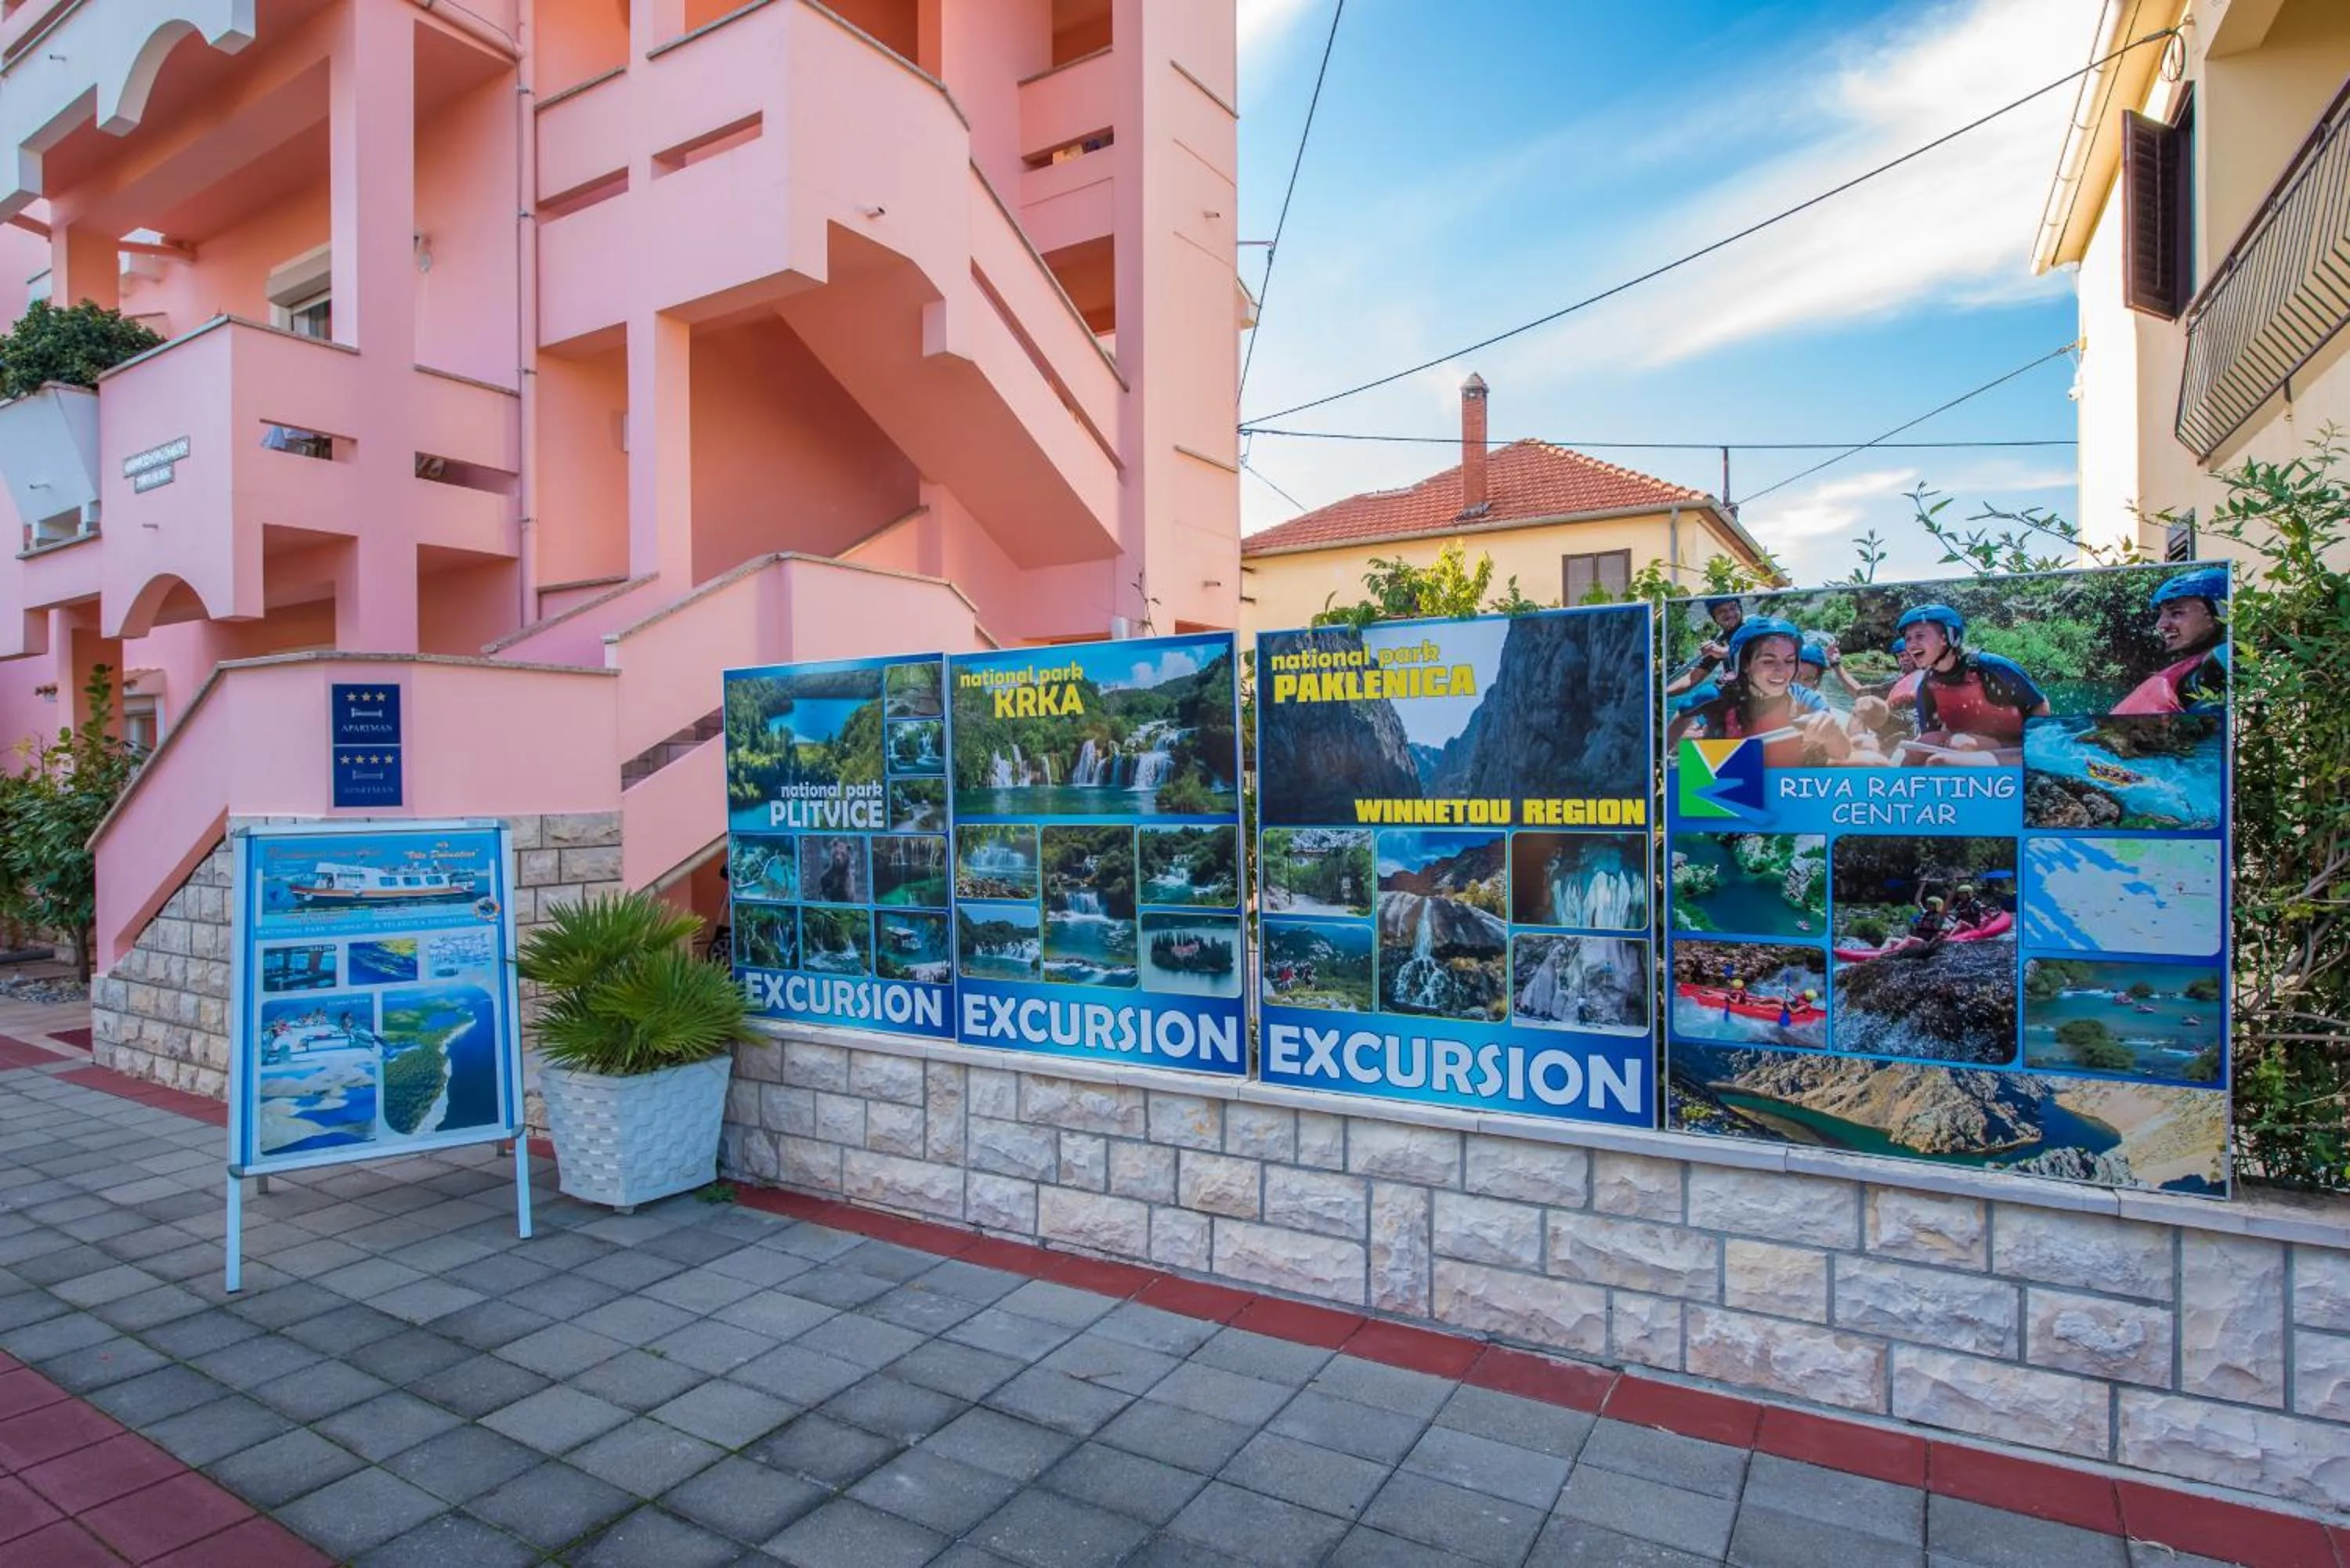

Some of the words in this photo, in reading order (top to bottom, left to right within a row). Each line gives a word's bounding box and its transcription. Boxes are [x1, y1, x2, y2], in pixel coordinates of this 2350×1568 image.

[1271, 644, 1370, 671] national
[1378, 640, 1440, 666] park
[960, 665, 1034, 688] national
[1039, 661, 1083, 683] park
[1274, 663, 1477, 703] PAKLENICA
[994, 684, 1085, 718] KRKA
[781, 782, 841, 798] national
[846, 780, 883, 799] park
[1780, 777, 1853, 797] RIVA
[1868, 775, 2016, 799] RAFTING
[770, 800, 884, 829] PLITVICE
[1354, 798, 1512, 824] WINNETOU
[1522, 797, 1646, 825] REGION
[1831, 803, 1957, 825] CENTAR
[744, 972, 943, 1028] EXCURSION
[963, 993, 1238, 1063] EXCURSION
[1268, 1024, 1642, 1114] EXCURSION
